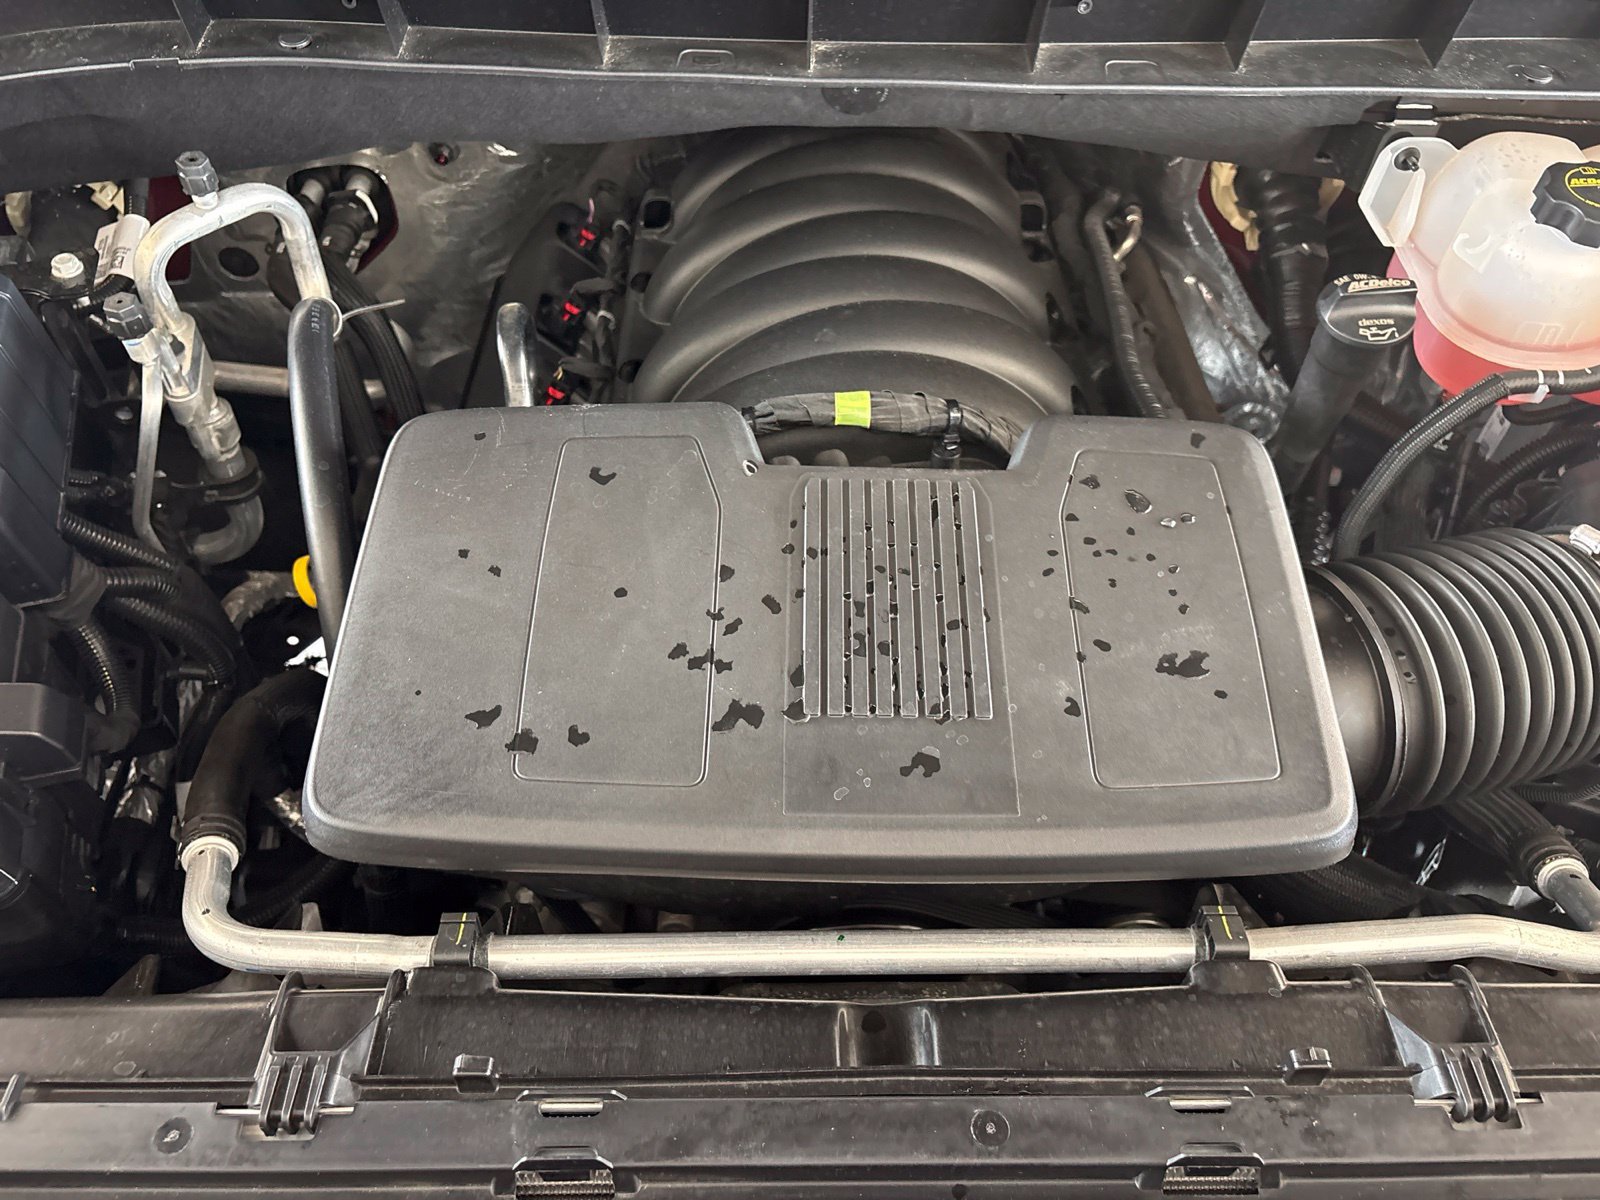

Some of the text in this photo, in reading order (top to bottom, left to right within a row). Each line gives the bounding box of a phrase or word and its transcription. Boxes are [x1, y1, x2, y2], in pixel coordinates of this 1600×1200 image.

[1334, 275, 1351, 287] SAE
[1347, 278, 1411, 293] ACDelco
[1358, 318, 1395, 327] dexos
